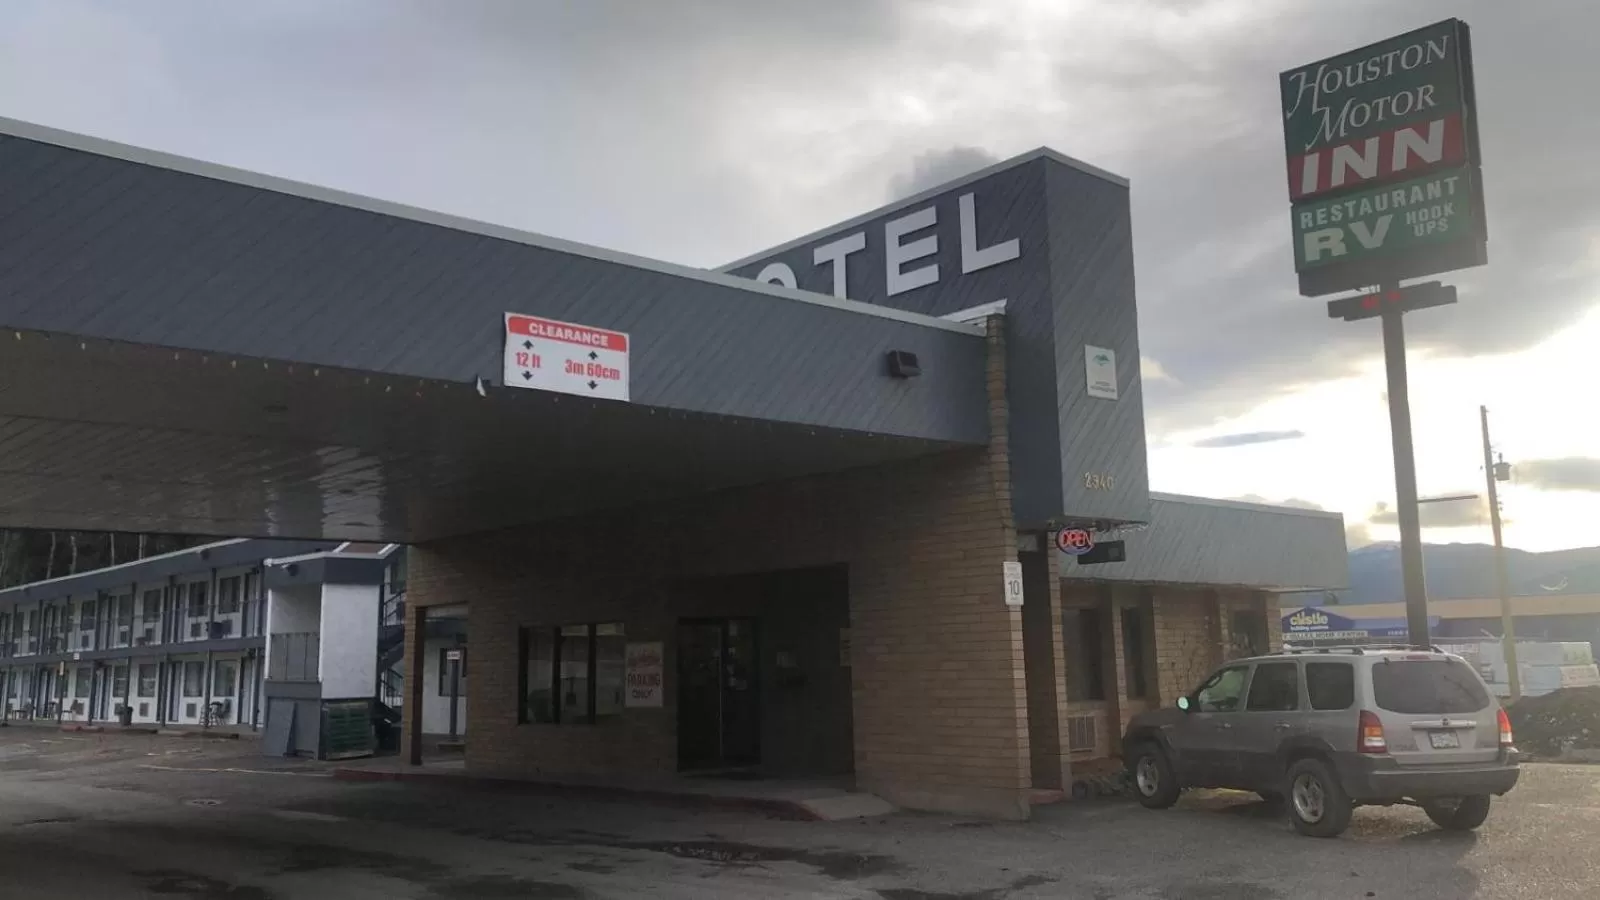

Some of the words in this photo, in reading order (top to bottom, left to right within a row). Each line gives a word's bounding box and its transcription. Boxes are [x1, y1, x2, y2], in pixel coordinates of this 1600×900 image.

[1286, 35, 1450, 119] HOUSTON
[1305, 83, 1439, 151] MOTOR
[1301, 118, 1446, 195] INN
[1301, 175, 1460, 230] RESTAURANT
[1405, 202, 1455, 226] HOOK
[1303, 213, 1394, 263] RV
[1414, 218, 1449, 238] UPS
[528, 322, 609, 347] CLEARANCE
[516, 352, 528, 367] 12
[564, 358, 584, 376] 3m
[586, 362, 621, 381] 60cm
[1059, 529, 1093, 547] OPEN
[1008, 580, 1020, 596] 10
[628, 673, 660, 687] PARKG
[632, 688, 654, 699] OY
